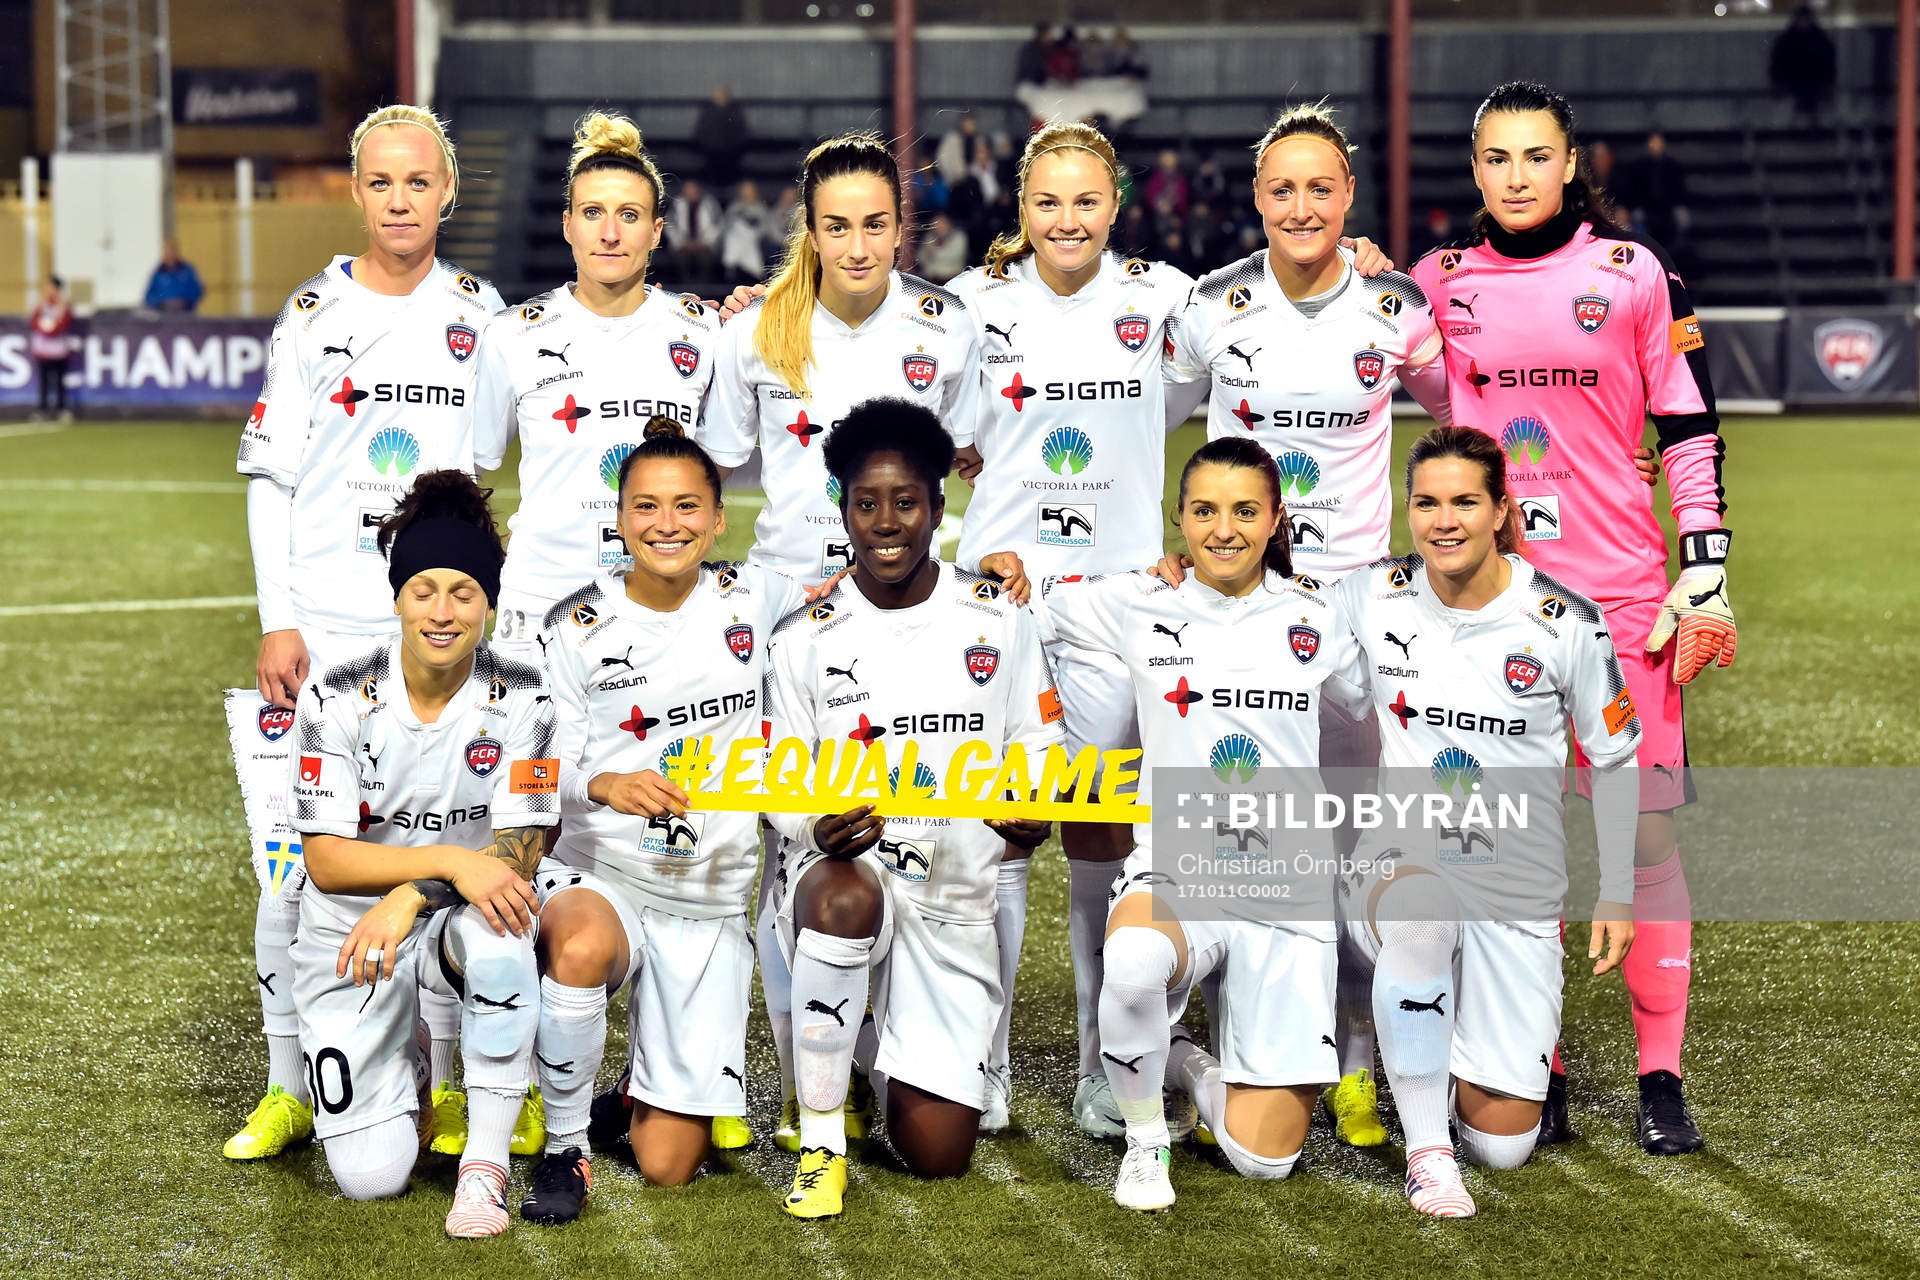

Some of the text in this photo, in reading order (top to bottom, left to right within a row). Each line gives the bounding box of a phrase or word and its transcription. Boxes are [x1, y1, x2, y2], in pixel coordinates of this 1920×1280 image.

[1578, 304, 1604, 316] FCR
[1120, 324, 1146, 335] FCR
[1450, 325, 1481, 337] stadium
[450, 333, 473, 346] FCR
[674, 350, 696, 364] FCR
[987, 354, 1024, 364] stadium
[908, 363, 933, 376] FCR
[1359, 361, 1381, 373] FCR
[536, 369, 583, 389] stadium
[1219, 374, 1259, 389] stadium
[1505, 470, 1572, 481] TORIA PARK
[346, 480, 404, 493] VICTORIA
[1022, 480, 1112, 491] VICTORIA PARK
[581, 500, 617, 509] VICTO
[805, 515, 842, 525] VICTO
[1040, 529, 1060, 538] OTTO
[1040, 536, 1091, 545] MAGNUSSON
[730, 634, 751, 647] FCR
[1293, 635, 1315, 647] FCR
[969, 656, 993, 667] FCR
[1148, 655, 1194, 667] stadium
[1378, 664, 1419, 679] stadium
[1508, 663, 1535, 680] FCR
[599, 675, 647, 692] stadium
[827, 691, 870, 709] stadium
[262, 711, 293, 724] FCR
[470, 748, 497, 760] FCR
[666, 734, 1143, 805] #EQUALGAME
[360, 780, 385, 792] dium
[315, 789, 335, 798] SPEL
[885, 816, 951, 827] TORIA PARK
[643, 837, 665, 845] OTTO
[642, 843, 695, 856] MAGNUSSON
